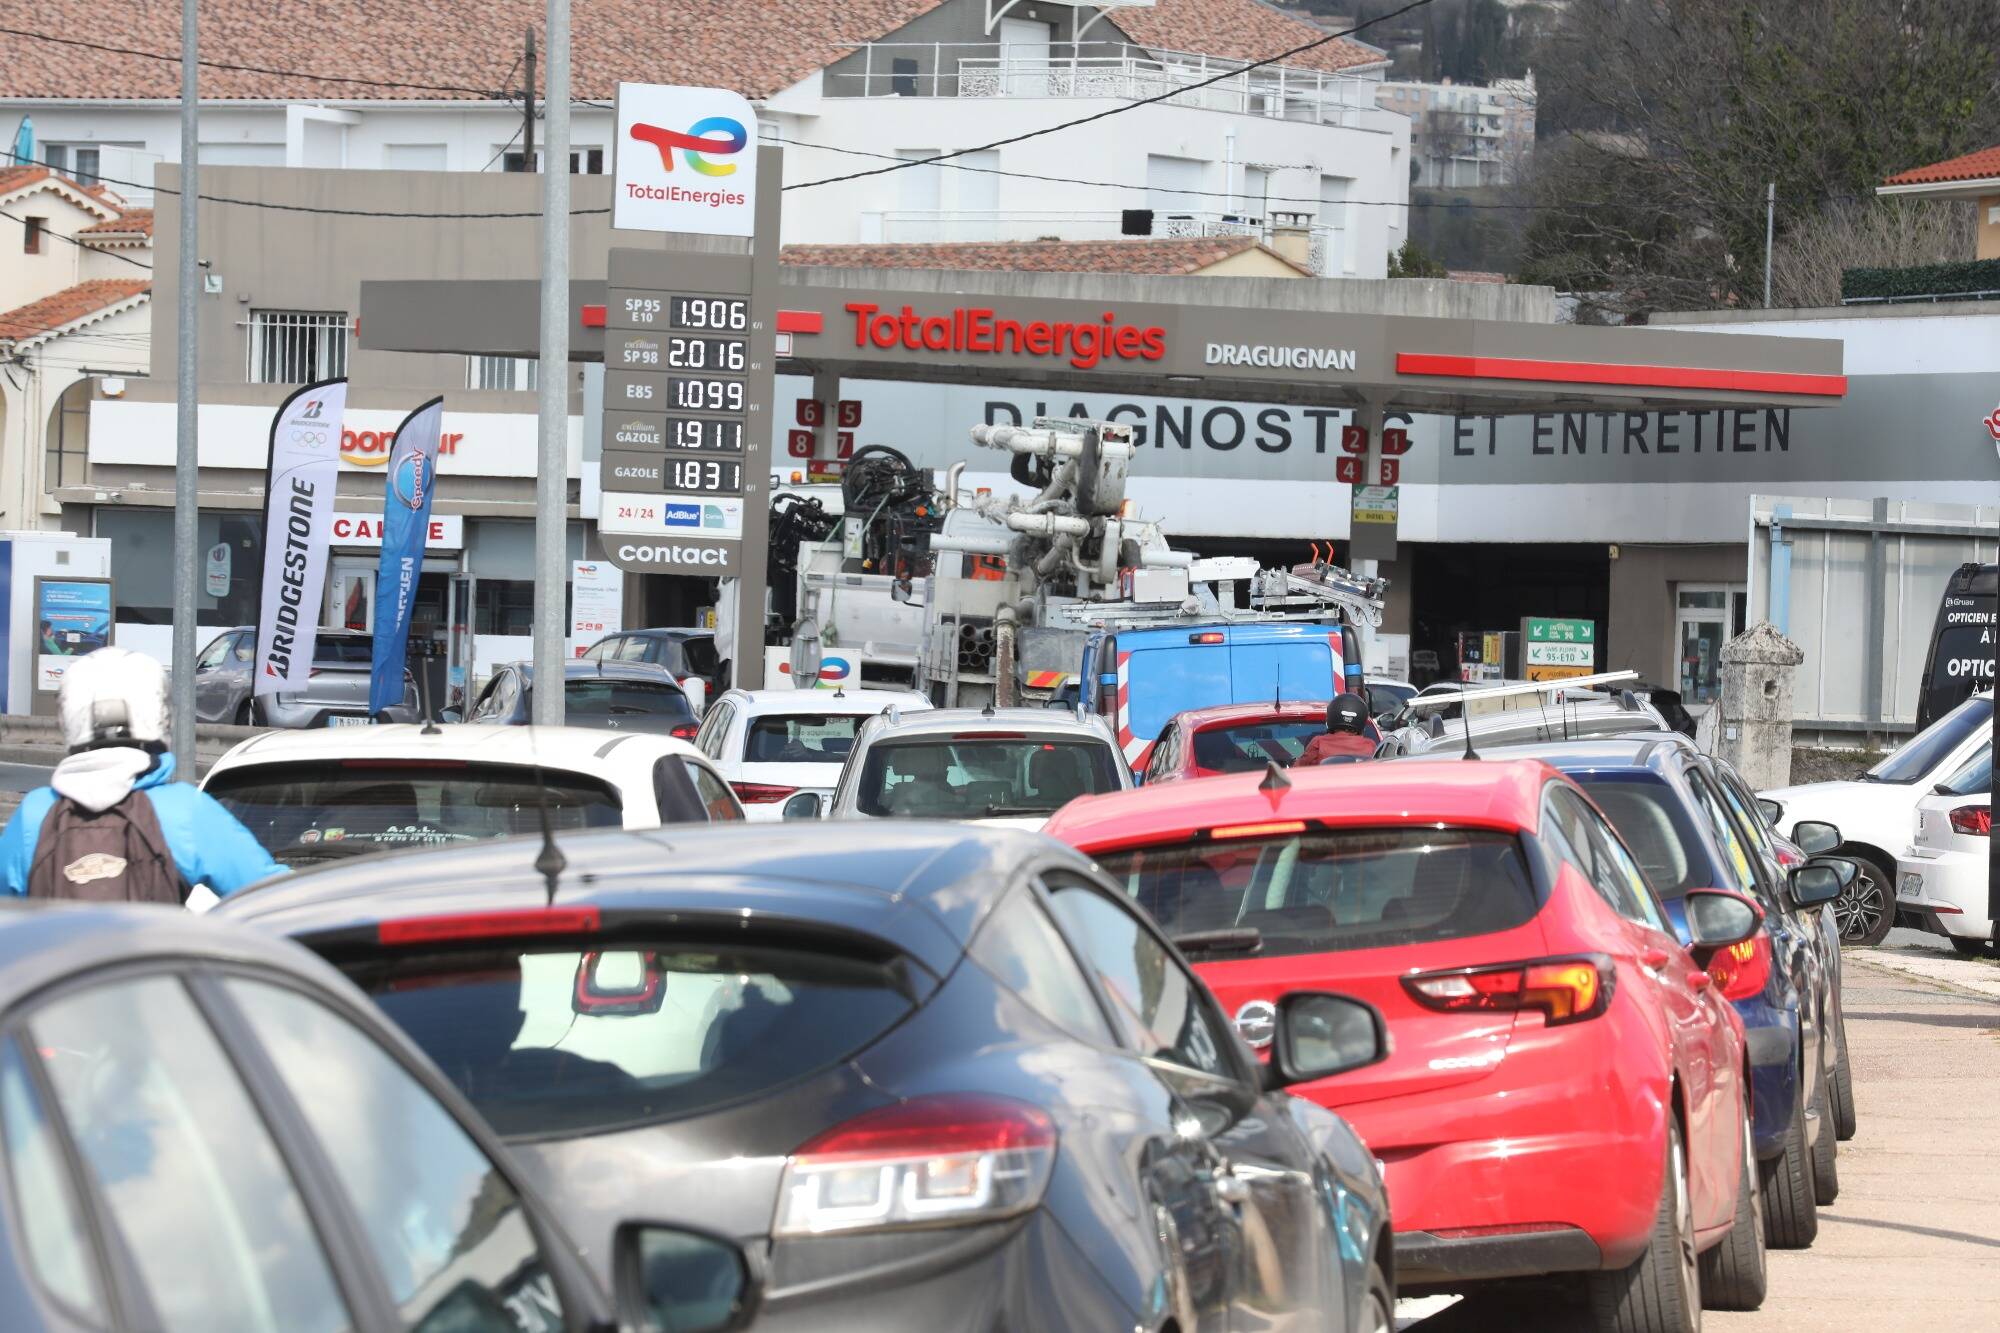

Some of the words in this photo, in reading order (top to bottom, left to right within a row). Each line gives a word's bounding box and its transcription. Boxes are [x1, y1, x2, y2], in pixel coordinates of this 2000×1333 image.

[626, 184, 745, 207] TotalEnergies
[626, 298, 661, 312] SP95
[681, 300, 746, 329] 1.906
[632, 313, 653, 322] E10
[845, 303, 1166, 369] TotalEnergies
[624, 350, 659, 363] SP98
[669, 339, 744, 370] 2.016
[1205, 343, 1356, 371] DRAGUIGNAN
[626, 385, 653, 399] E85
[678, 380, 743, 410] 1.099
[804, 403, 815, 422] 6
[845, 404, 856, 423] 5
[616, 432, 660, 444] GAZOLE
[677, 420, 742, 448] 1.911
[1350, 430, 1360, 449] 2
[1391, 432, 1399, 450] 1
[1533, 408, 1791, 456] ENTRETIEN
[795, 435, 807, 454] 8
[837, 436, 848, 455] 7
[411, 443, 425, 514] Speedy
[614, 467, 659, 479] GAZOLE
[675, 461, 740, 490] 1.831
[1343, 461, 1355, 479] 4
[1382, 463, 1392, 480] 3
[618, 507, 631, 518] 24
[641, 508, 654, 519] 24
[618, 545, 728, 566] contact
[266, 476, 315, 681] BRIDGESTONE
[1953, 598, 1975, 606] Gruau
[1947, 612, 1989, 623] OPTICIEN
[1546, 653, 1575, 662] 95-E10
